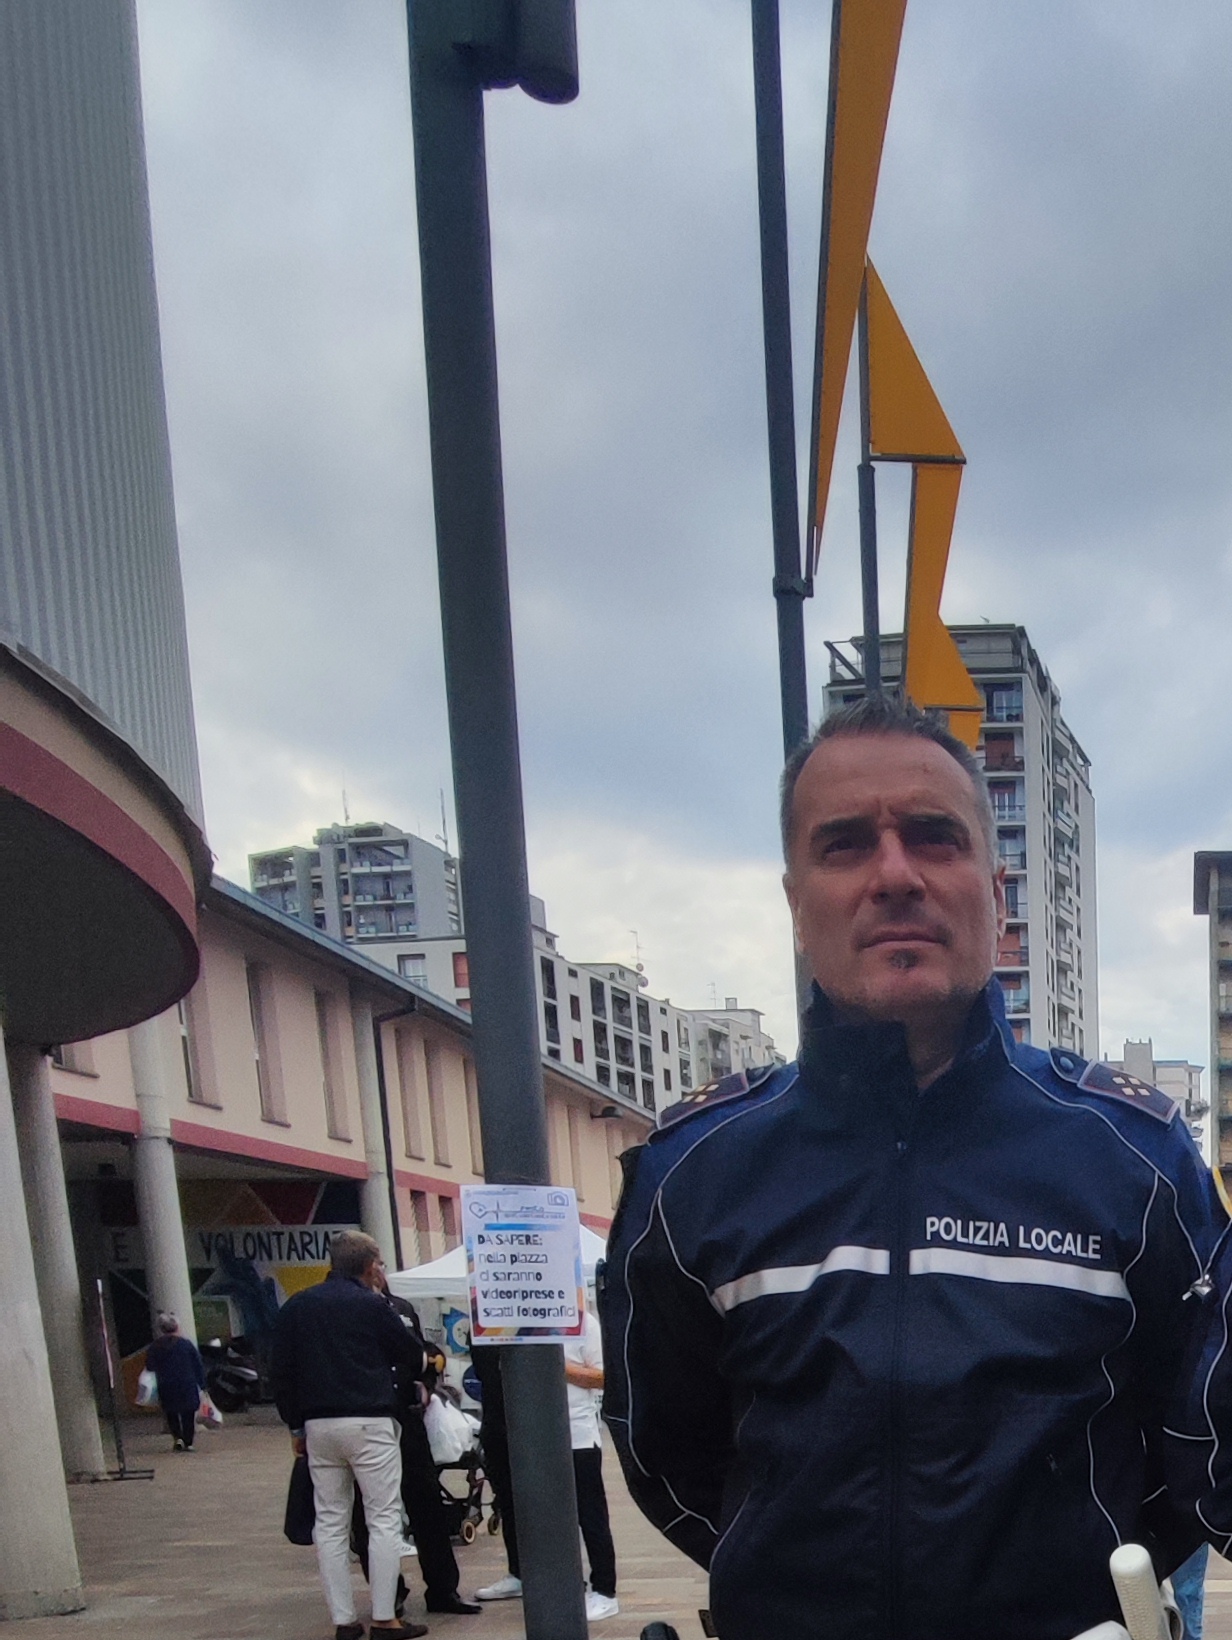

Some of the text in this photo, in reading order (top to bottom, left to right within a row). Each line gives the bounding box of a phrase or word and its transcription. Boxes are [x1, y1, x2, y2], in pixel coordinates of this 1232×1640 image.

[477, 1234, 543, 1246] DA SAPERE:
[925, 1216, 1101, 1260] POLIZIA LOCALE
[198, 1230, 342, 1262] VOLONTARIA
[479, 1251, 548, 1265] nella piazza
[493, 1271, 543, 1281] saranno
[481, 1287, 566, 1302] videoriprese e
[483, 1305, 576, 1319] scatti fotografici
